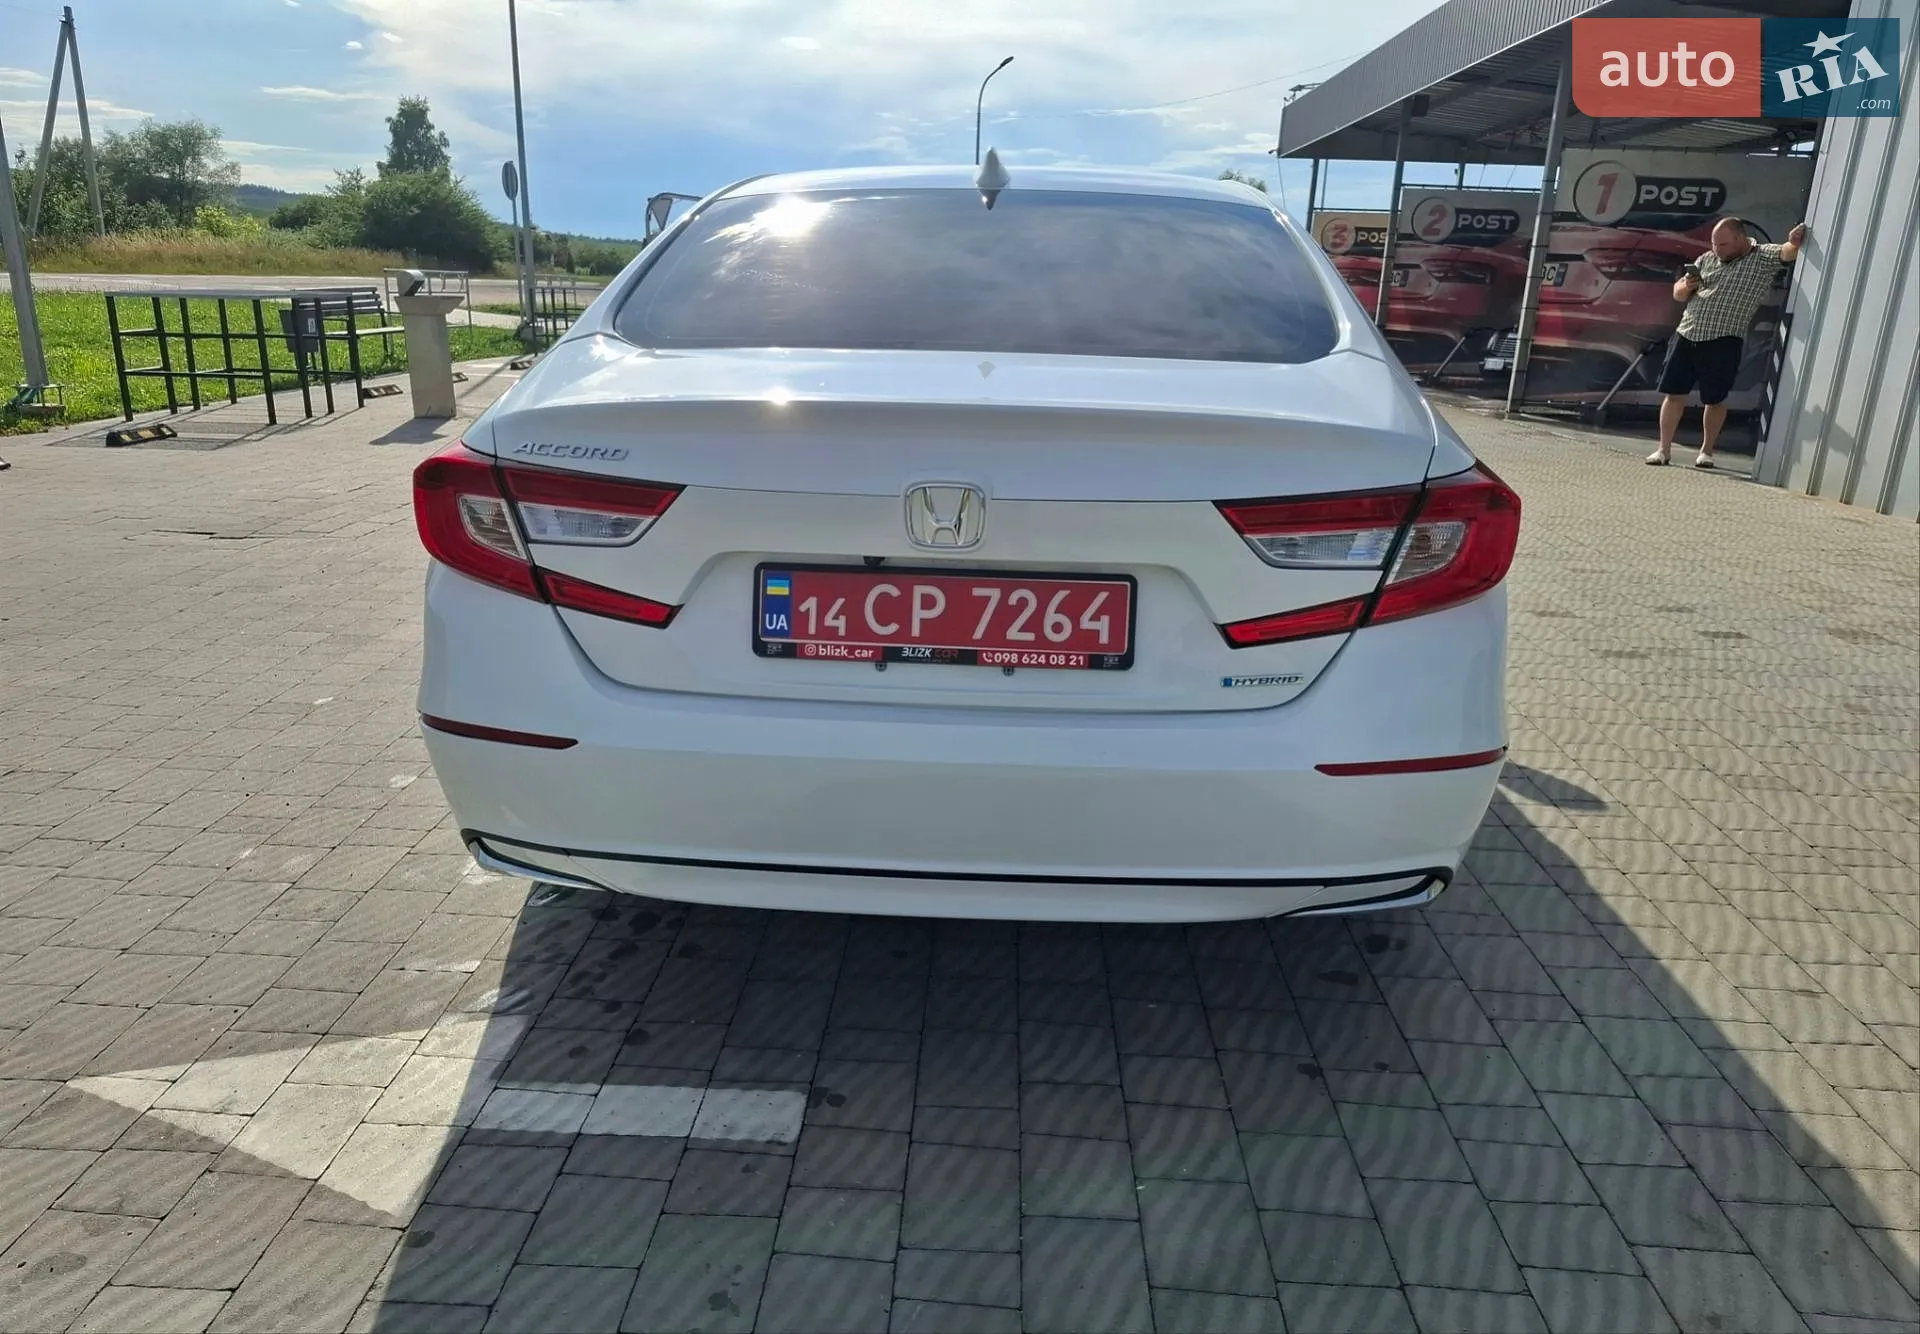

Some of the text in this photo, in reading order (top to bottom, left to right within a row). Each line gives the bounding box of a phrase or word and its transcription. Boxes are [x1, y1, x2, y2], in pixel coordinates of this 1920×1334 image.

[1595, 172, 1721, 216] 1 POST
[1421, 204, 1516, 237] 2 POST
[1331, 223, 1388, 249] 3 POS
[512, 440, 630, 461] ACCORD
[765, 613, 789, 631] UA
[798, 583, 1111, 645] 14 CP 7264
[818, 644, 875, 659] blizk_car
[994, 652, 1085, 666] 098 624 08 21
[1234, 676, 1300, 687] HYBRID
